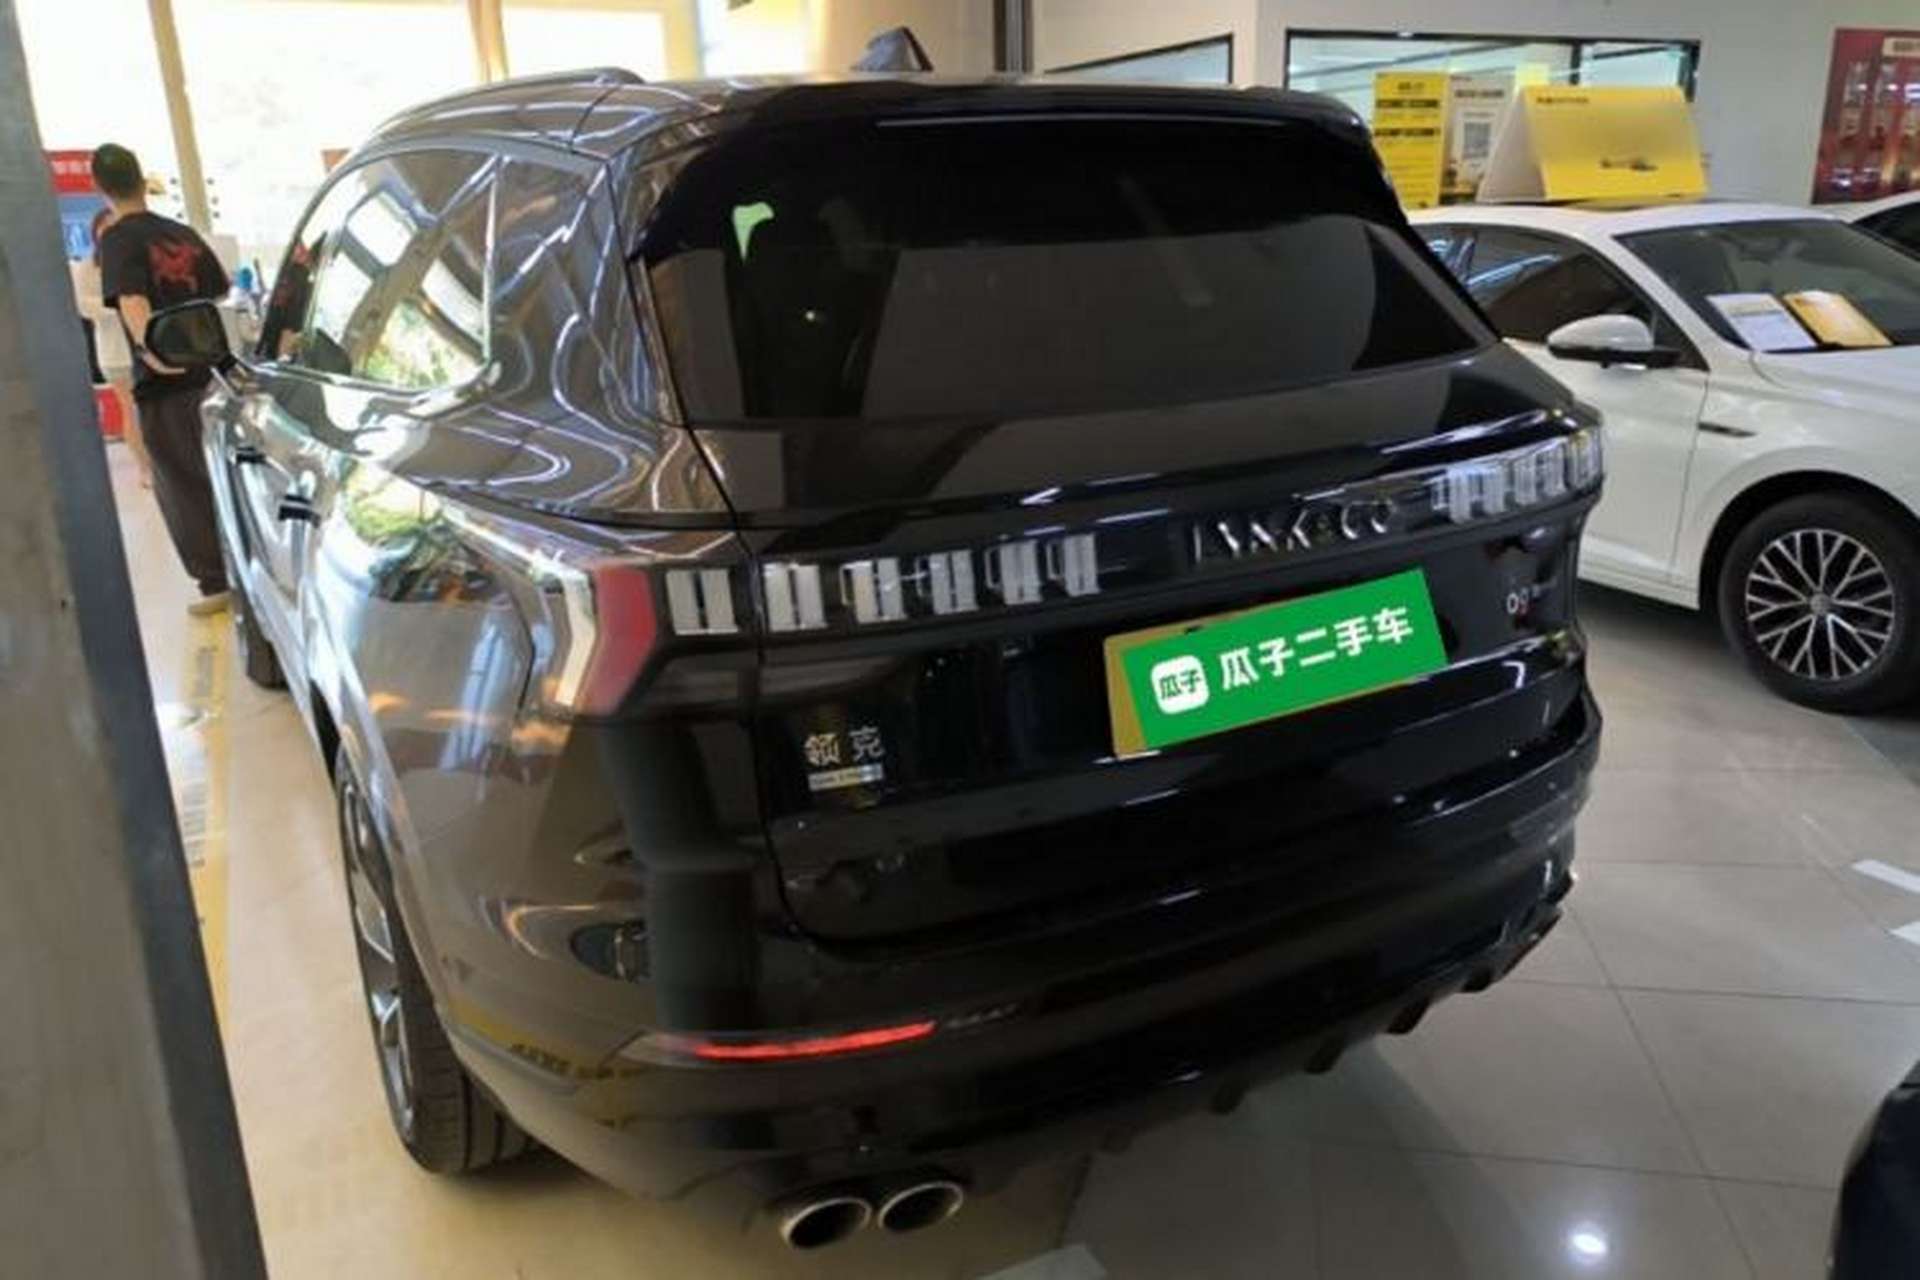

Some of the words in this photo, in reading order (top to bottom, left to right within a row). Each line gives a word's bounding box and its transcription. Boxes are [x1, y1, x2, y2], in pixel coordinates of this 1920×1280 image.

[1157, 669, 1202, 701] 瓜子
[1219, 607, 1414, 690] 瓜子二手车
